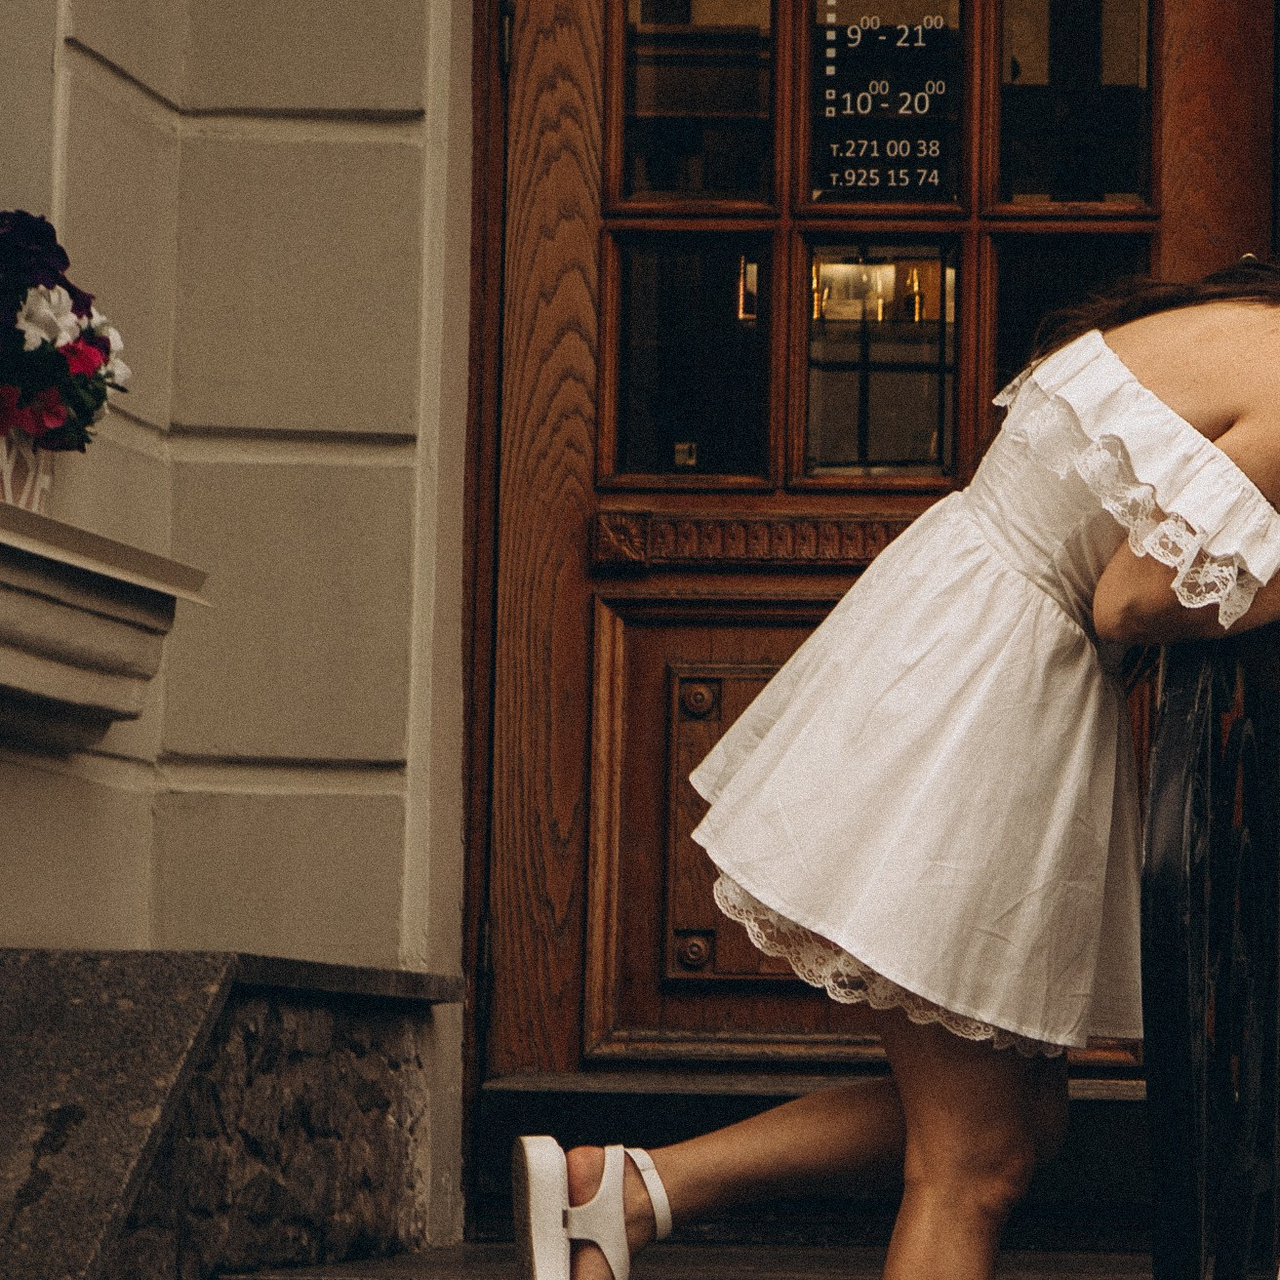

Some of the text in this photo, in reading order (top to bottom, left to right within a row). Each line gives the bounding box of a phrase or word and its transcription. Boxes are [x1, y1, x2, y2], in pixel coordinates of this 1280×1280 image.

[886, 140, 910, 157] 00
[917, 140, 940, 157] 38
[887, 170, 909, 187] 15
[917, 170, 939, 187] 74
